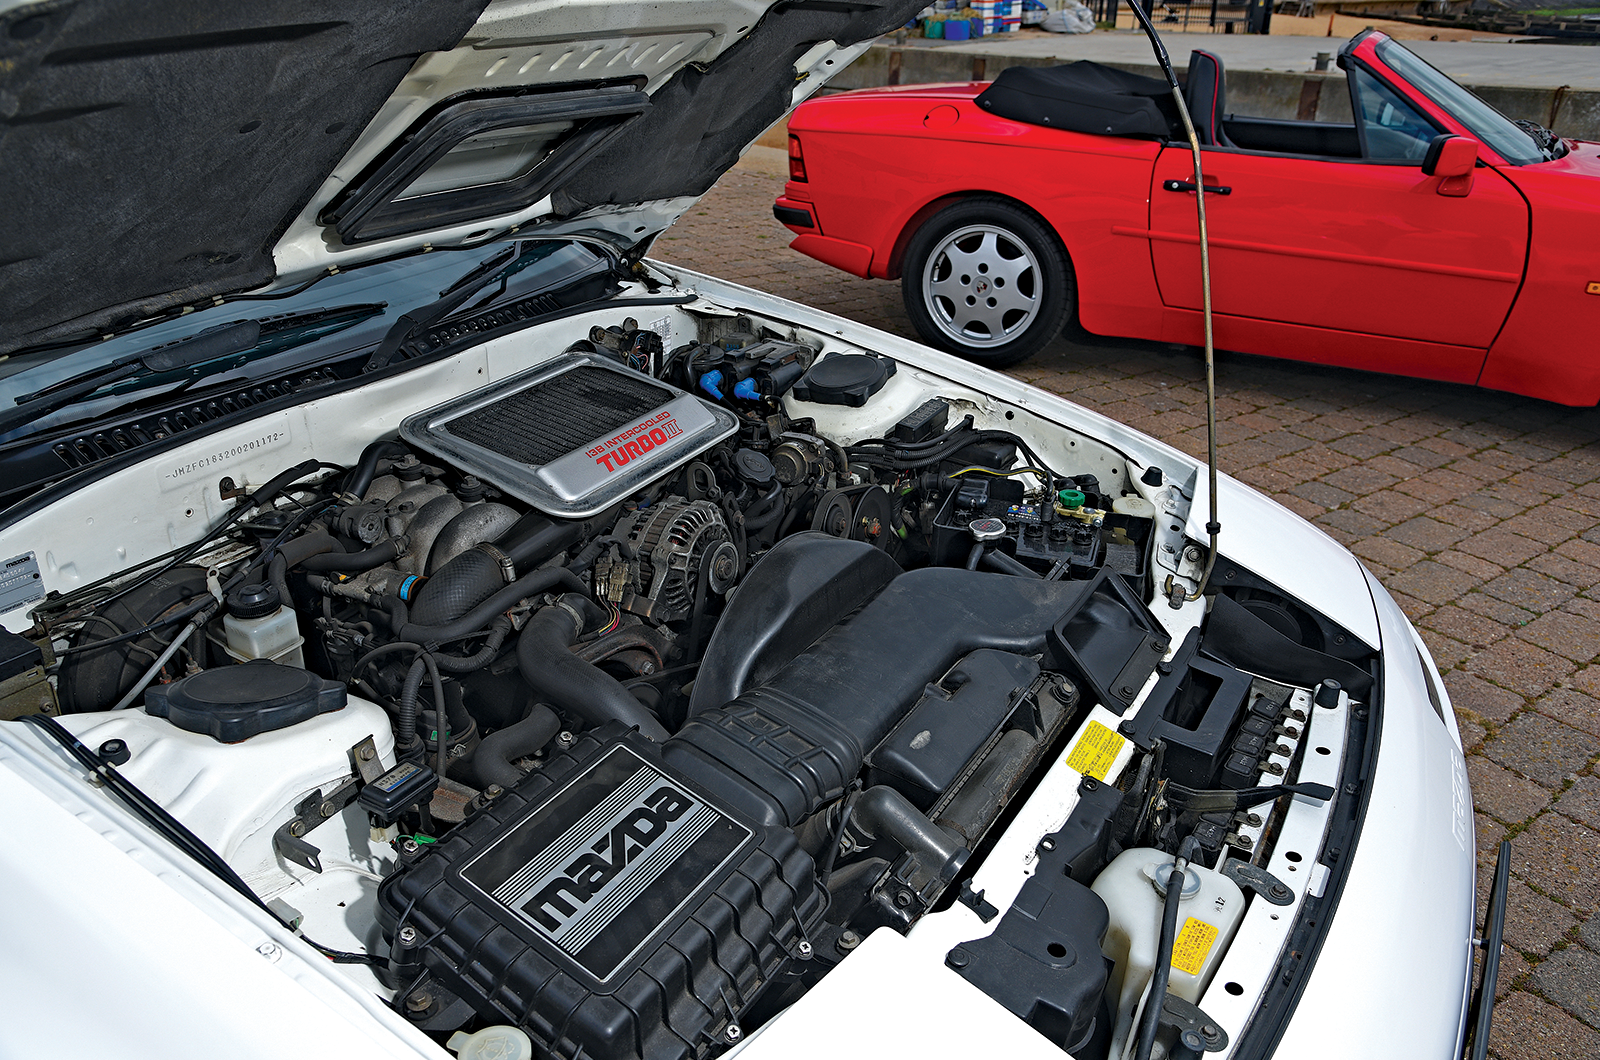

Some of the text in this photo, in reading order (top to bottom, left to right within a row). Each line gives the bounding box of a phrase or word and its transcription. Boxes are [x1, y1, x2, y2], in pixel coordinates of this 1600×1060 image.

[596, 427, 668, 473] TURBO
[604, 411, 671, 448] INTERCOOLED
[6, 556, 30, 568] mazda
[520, 786, 695, 933] mazda
